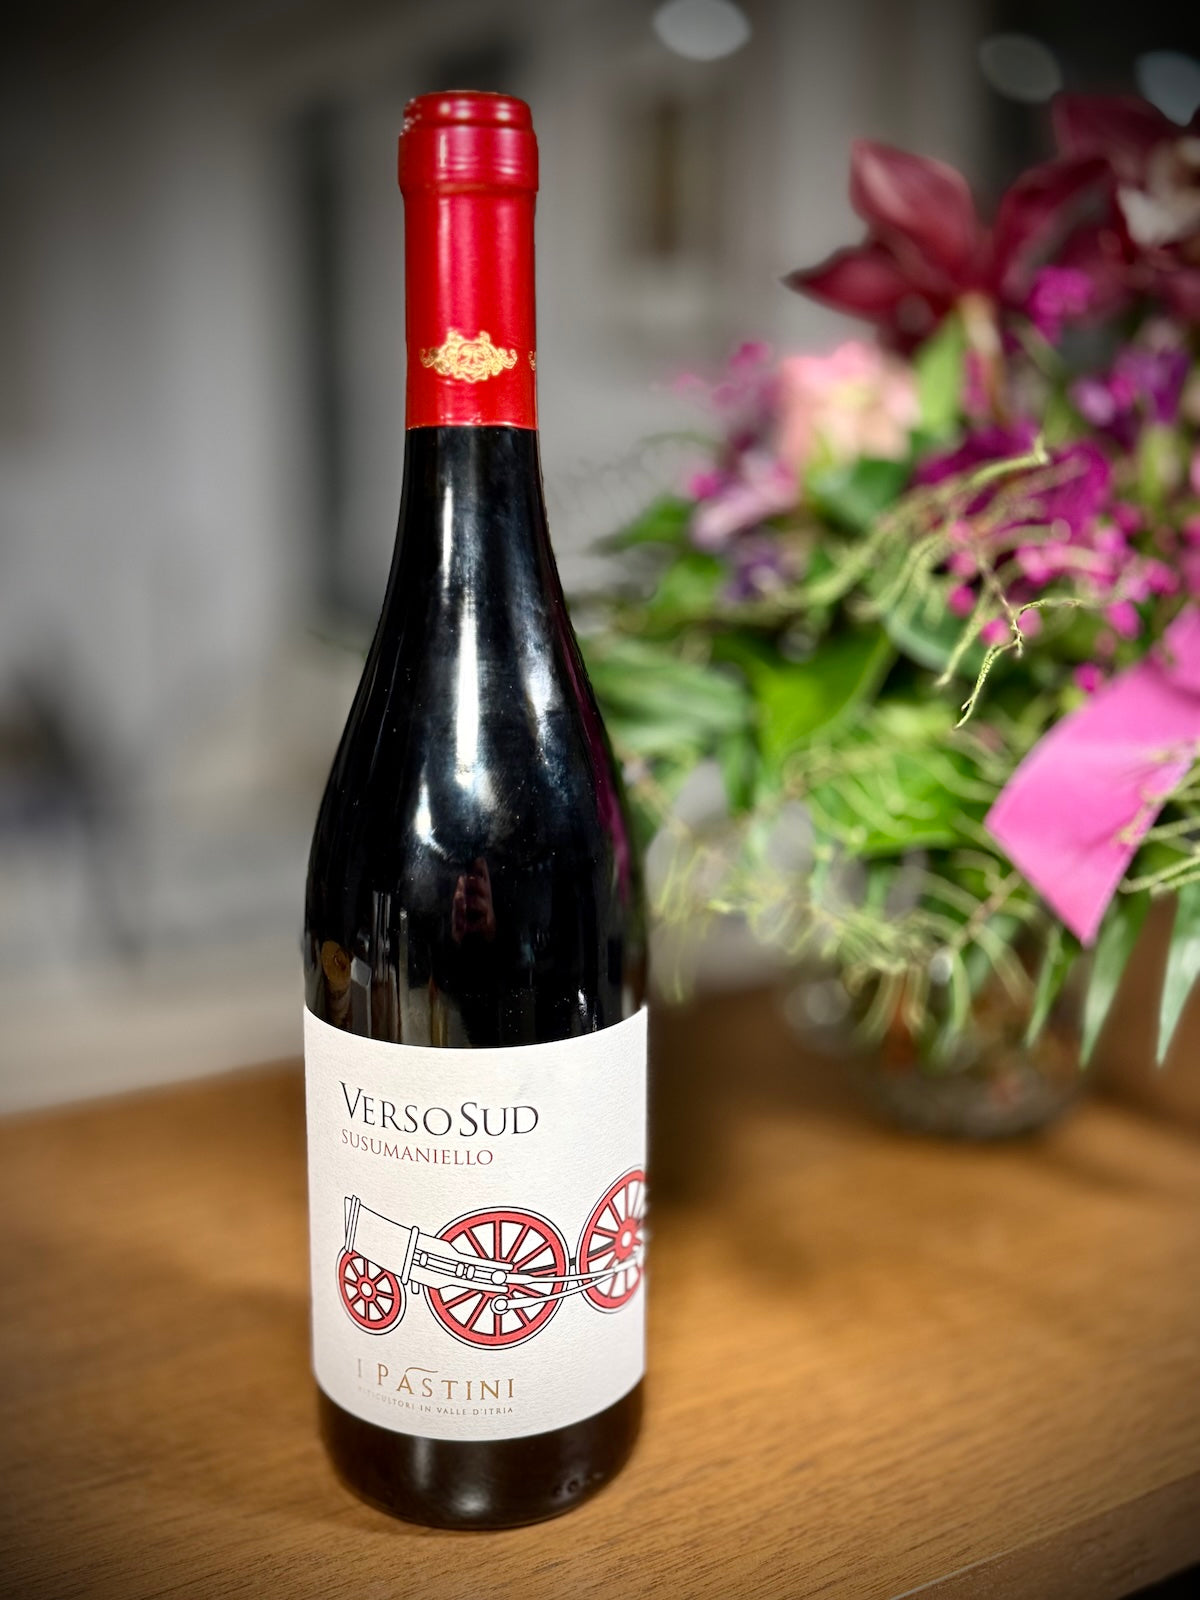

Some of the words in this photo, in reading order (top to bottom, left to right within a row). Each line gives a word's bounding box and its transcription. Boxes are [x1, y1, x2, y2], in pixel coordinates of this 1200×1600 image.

[341, 1128, 494, 1166] SUSUMANIELLO
[357, 1358, 363, 1379] I
[420, 1404, 432, 1414] IN
[436, 1407, 467, 1416] VALLE
[472, 1406, 514, 1416] D'ITRIA
